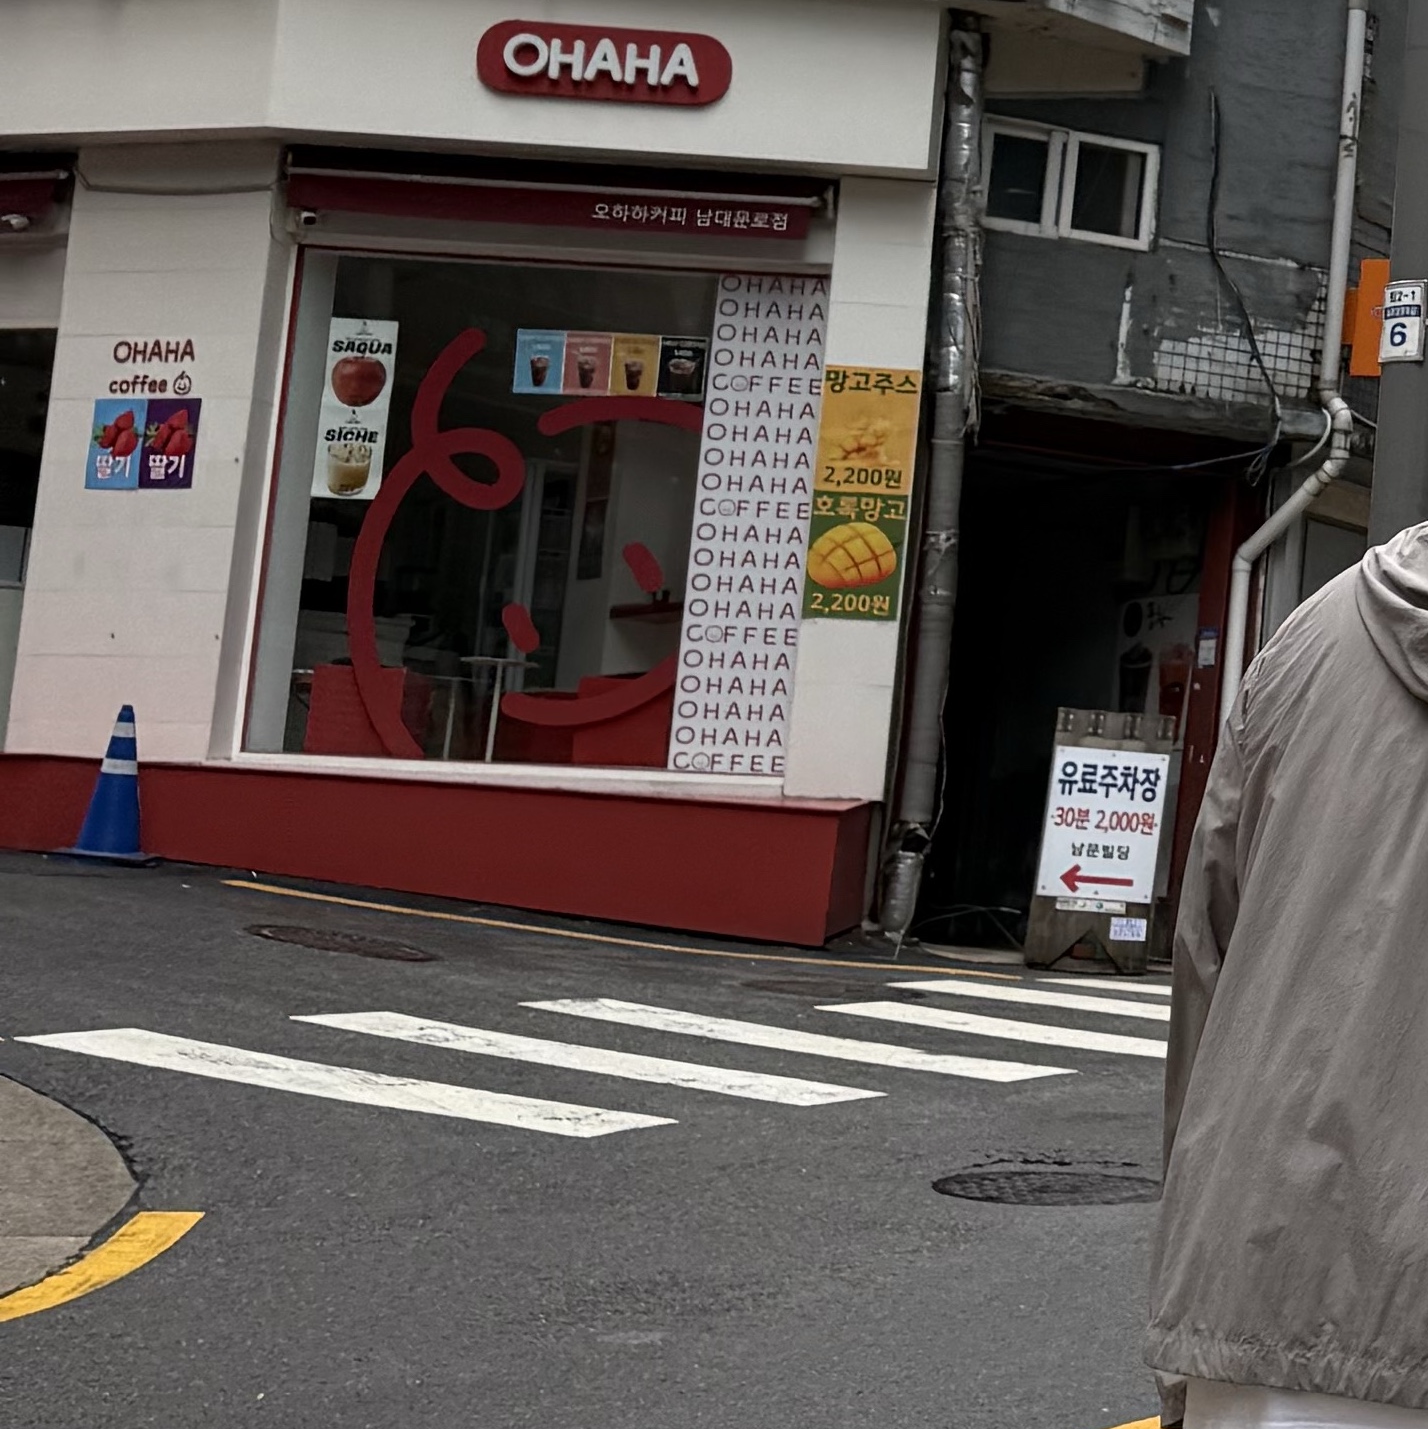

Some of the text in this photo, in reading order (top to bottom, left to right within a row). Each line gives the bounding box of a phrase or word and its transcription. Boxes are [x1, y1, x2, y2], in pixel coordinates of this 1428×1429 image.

[503, 33, 699, 88] OHAHA
[592, 202, 687, 225] 오하하커피
[722, 275, 826, 296] OHAHA
[719, 298, 825, 321] OHAHA
[717, 323, 823, 346] OHAHA
[1390, 322, 1407, 347] 6
[112, 339, 196, 364] OHAHA
[714, 348, 820, 371] OHAHA
[109, 375, 168, 395] coffee
[825, 370, 919, 395] 망고주스
[709, 397, 815, 419] OHAHA
[707, 423, 813, 445] OHAHA
[704, 448, 810, 469] OHAHA
[701, 473, 808, 494] OHAHA
[823, 465, 902, 489] 2,200원
[696, 523, 803, 545] OHAHA
[694, 548, 801, 570] OHAHA
[691, 573, 798, 595] OHAHA
[688, 598, 796, 620] OHAHA
[810, 593, 890, 616] 2,200원
[683, 649, 790, 671] OHAHA
[680, 675, 787, 697] OHAHA
[678, 700, 785, 722] OHAHA
[675, 726, 782, 747] OHAHA
[1058, 760, 1161, 803] 유료주차장
[1053, 806, 1156, 836] 30분 2,000원
